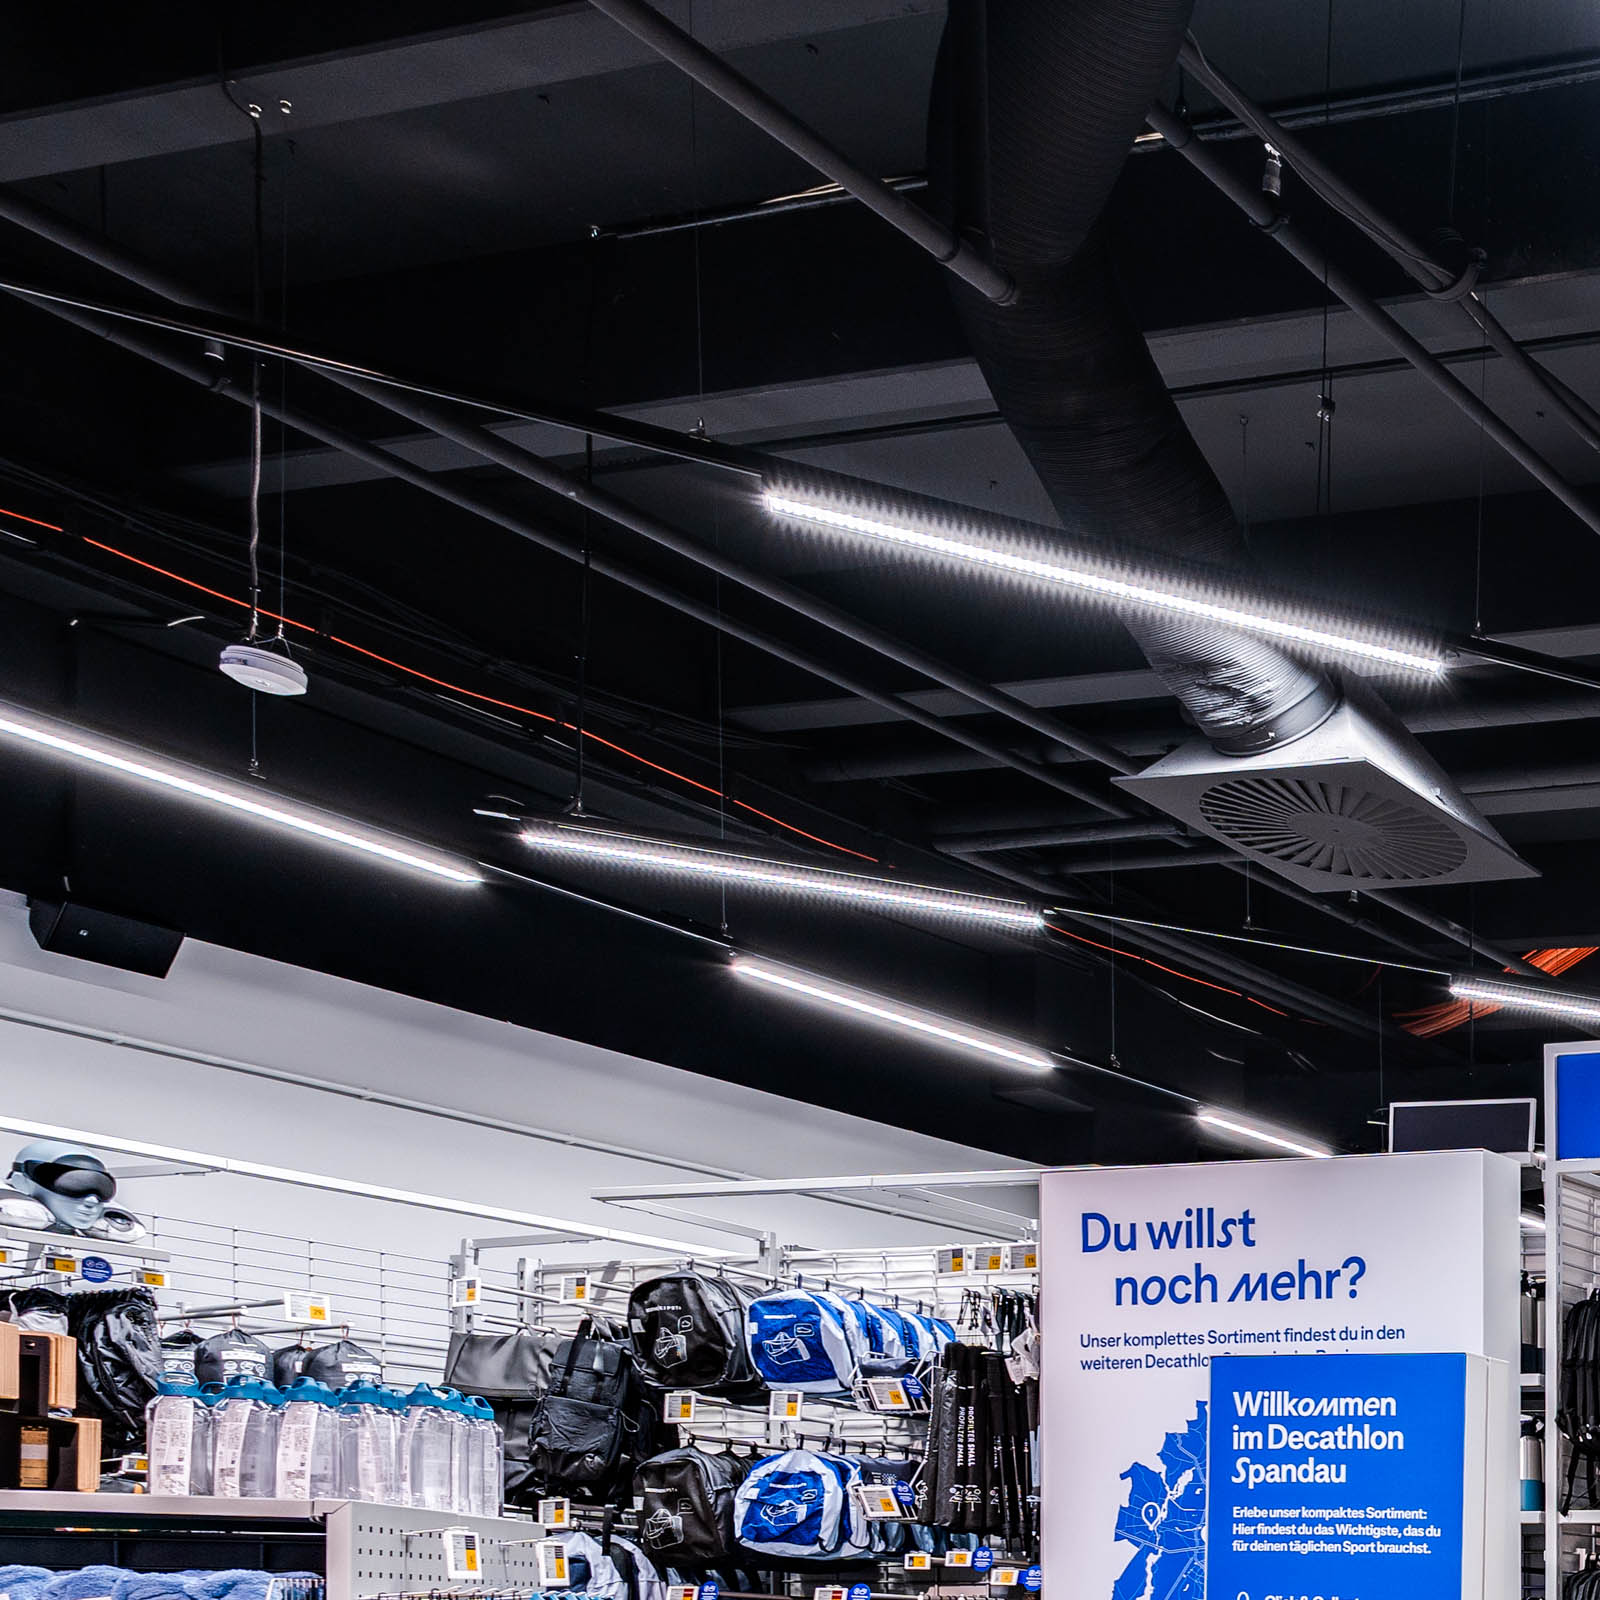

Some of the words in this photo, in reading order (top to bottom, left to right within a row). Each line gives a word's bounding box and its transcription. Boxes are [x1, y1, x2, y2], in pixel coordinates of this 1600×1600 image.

[1081, 1212, 1137, 1253] Du
[1146, 1208, 1256, 1249] willst
[1115, 1262, 1218, 1306] noch
[1227, 1256, 1367, 1303] mehr?
[1080, 1332, 1122, 1348] Unser
[1123, 1331, 1205, 1349] komplettes
[1207, 1329, 1281, 1345] Sortiment
[1284, 1327, 1336, 1342] findest
[1339, 1326, 1358, 1341] du
[1360, 1326, 1374, 1340] in
[1376, 1325, 1405, 1340] den
[1080, 1354, 1143, 1371] weiteren
[1145, 1352, 1211, 1369] Decathlo
[1232, 1391, 1397, 1417] Willkommen
[967, 1406, 975, 1445] PROFILTER
[1232, 1425, 1263, 1450] im
[1267, 1423, 1405, 1450] Decathlon
[968, 1445, 976, 1467] SMALL
[1231, 1457, 1347, 1489] Spandau
[1232, 1506, 1268, 1518] Erlebe
[1269, 1508, 1300, 1518] unser
[1301, 1507, 1365, 1521] kompaktes
[1366, 1507, 1427, 1520] Sortiment:
[1232, 1523, 1257, 1536] Hier
[1257, 1524, 1298, 1536] findest
[1298, 1524, 1313, 1536] du
[1313, 1524, 1334, 1536] das
[1335, 1524, 1402, 1539] Wichtigste,
[1403, 1525, 1425, 1537] das
[1425, 1525, 1441, 1537] du
[1232, 1540, 1249, 1552] für
[1250, 1540, 1288, 1552] deinen
[1288, 1541, 1341, 1555] täglichen
[1342, 1541, 1377, 1555] Sport
[1377, 1541, 1432, 1554] brauchst.
